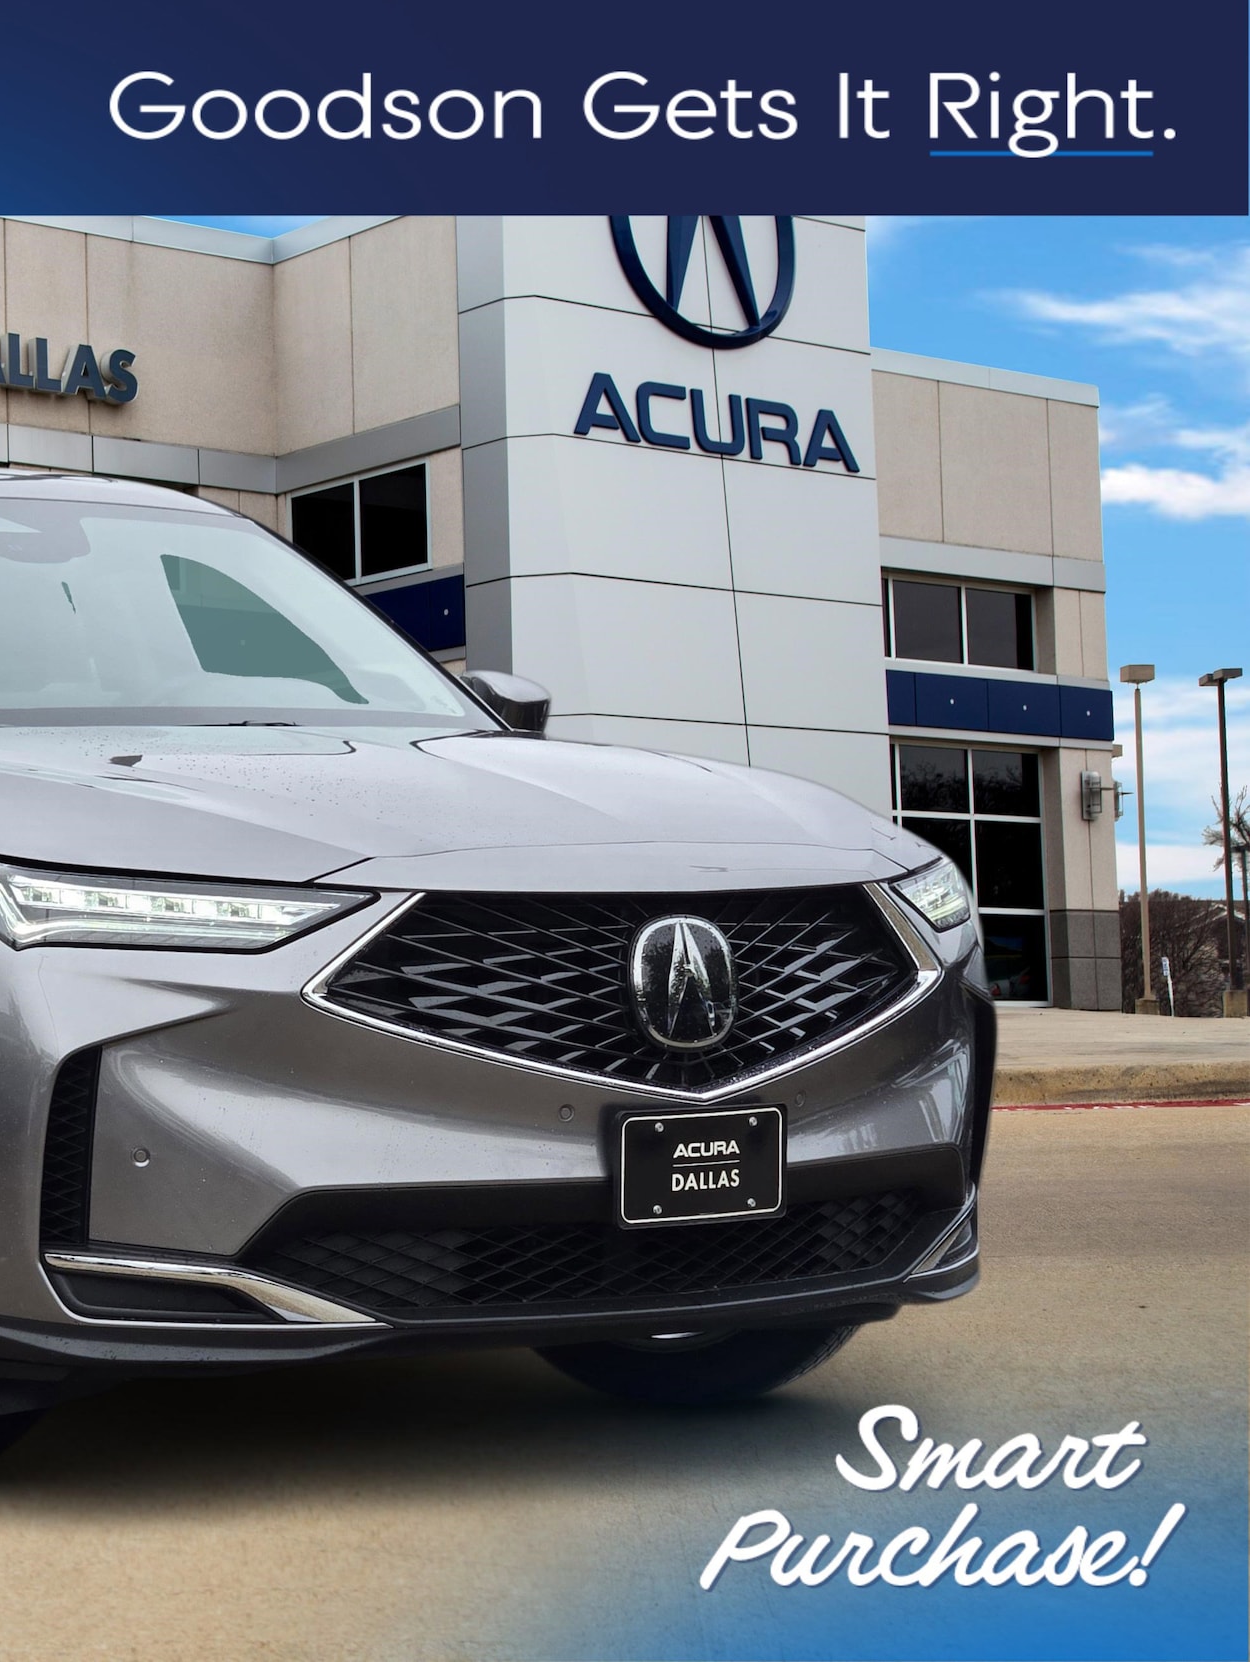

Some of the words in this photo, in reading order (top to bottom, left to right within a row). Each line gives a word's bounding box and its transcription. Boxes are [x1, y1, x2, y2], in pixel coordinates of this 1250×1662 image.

[573, 372, 860, 475] ACURA
[673, 1139, 740, 1159] ACURA
[671, 1168, 740, 1192] DALLAS
